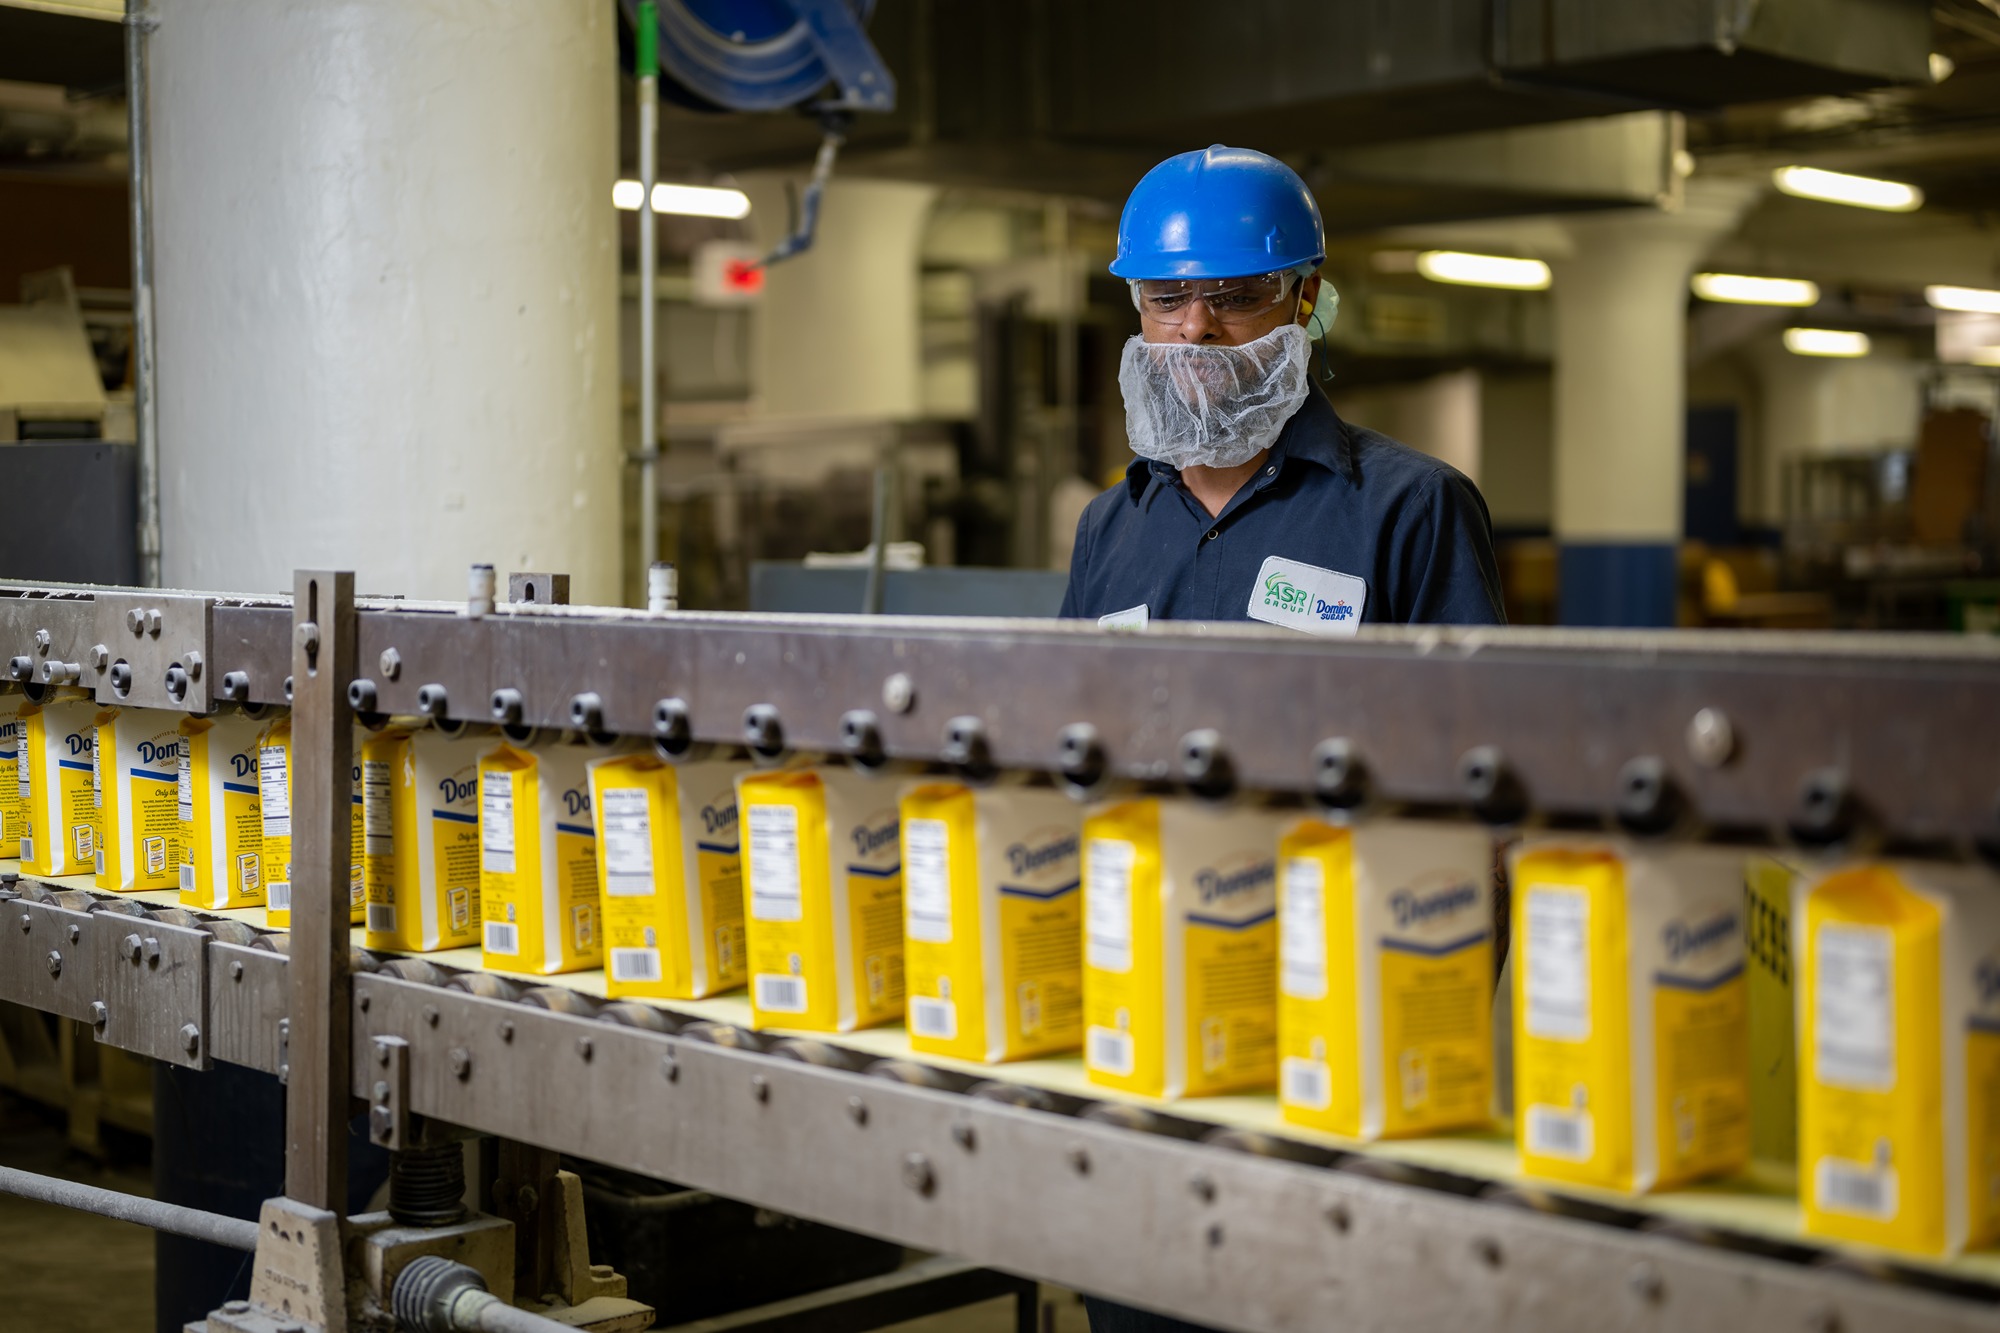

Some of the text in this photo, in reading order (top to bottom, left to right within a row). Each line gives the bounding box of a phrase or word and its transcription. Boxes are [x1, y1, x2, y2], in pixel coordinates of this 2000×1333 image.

[1265, 583, 1308, 607] ASR
[1263, 597, 1304, 614] GROUP
[1315, 599, 1353, 615] Domino
[1320, 612, 1346, 621] SUGAR
[280, 771, 287, 779] 30
[155, 789, 168, 798] Only
